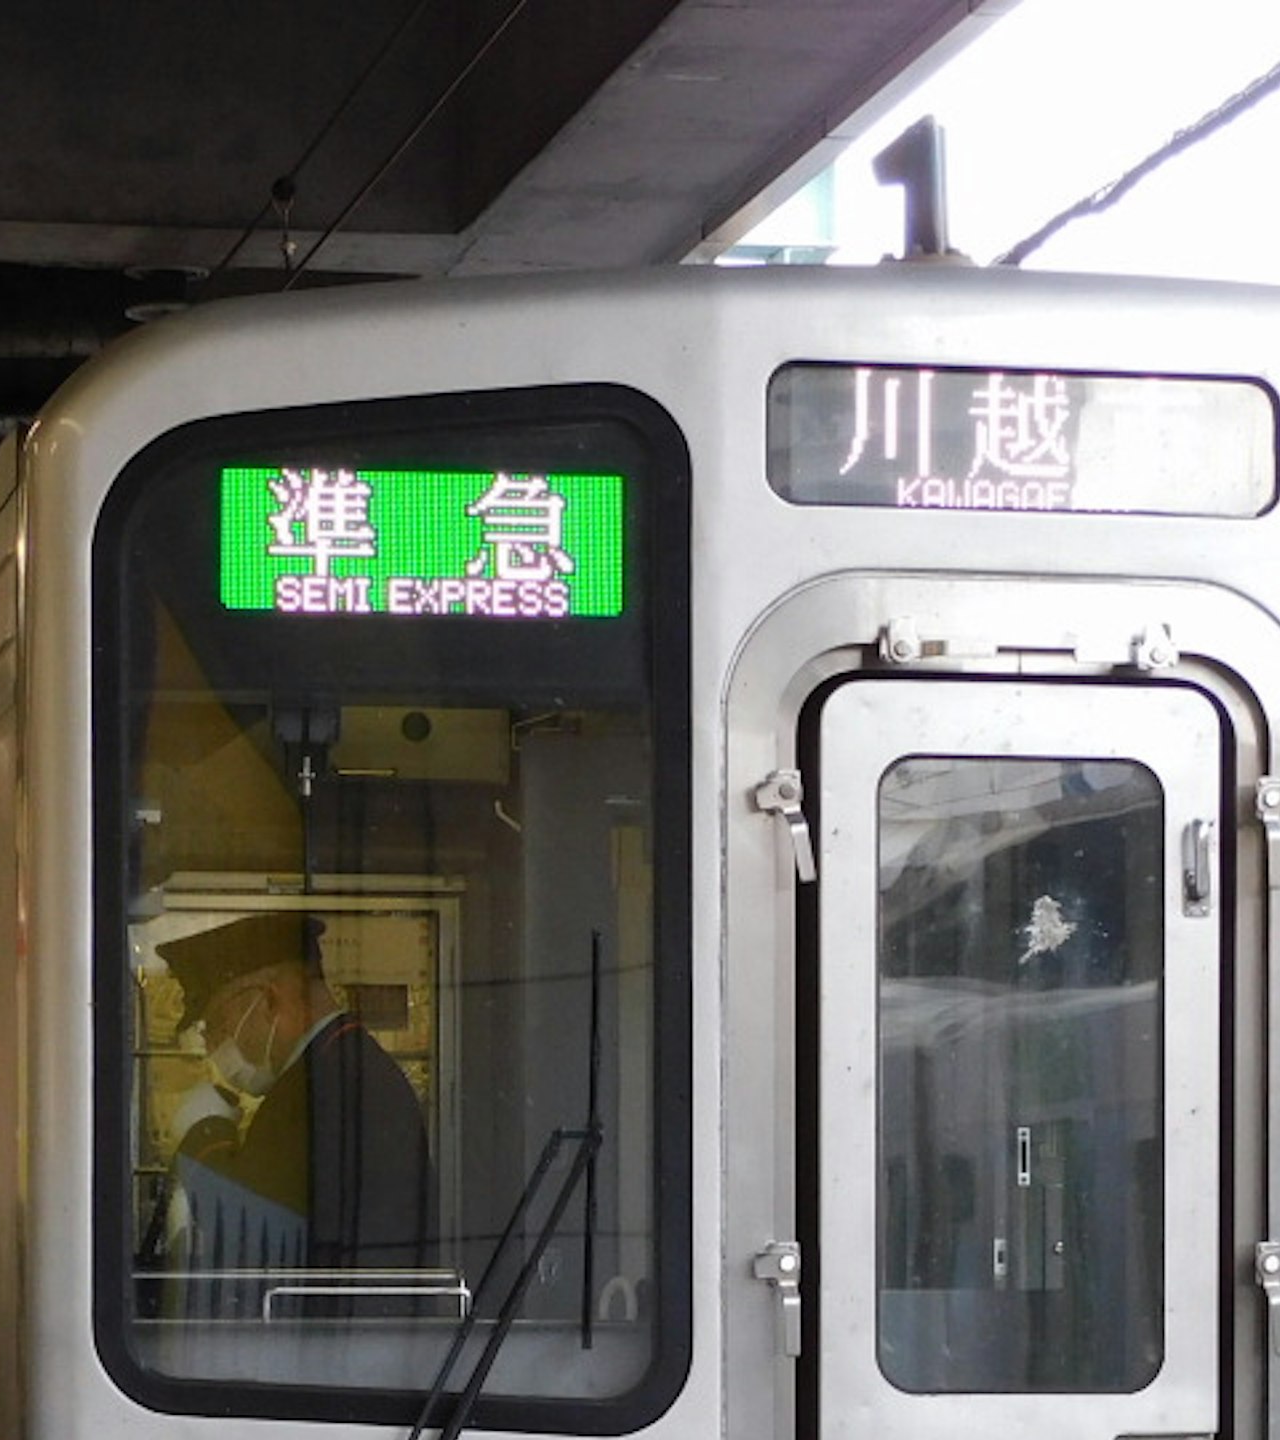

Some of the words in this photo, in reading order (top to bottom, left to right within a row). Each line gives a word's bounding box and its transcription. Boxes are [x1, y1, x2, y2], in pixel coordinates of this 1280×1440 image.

[267, 468, 576, 578] 準急
[275, 576, 372, 613] SEMI
[387, 577, 570, 618] EXPRESS
